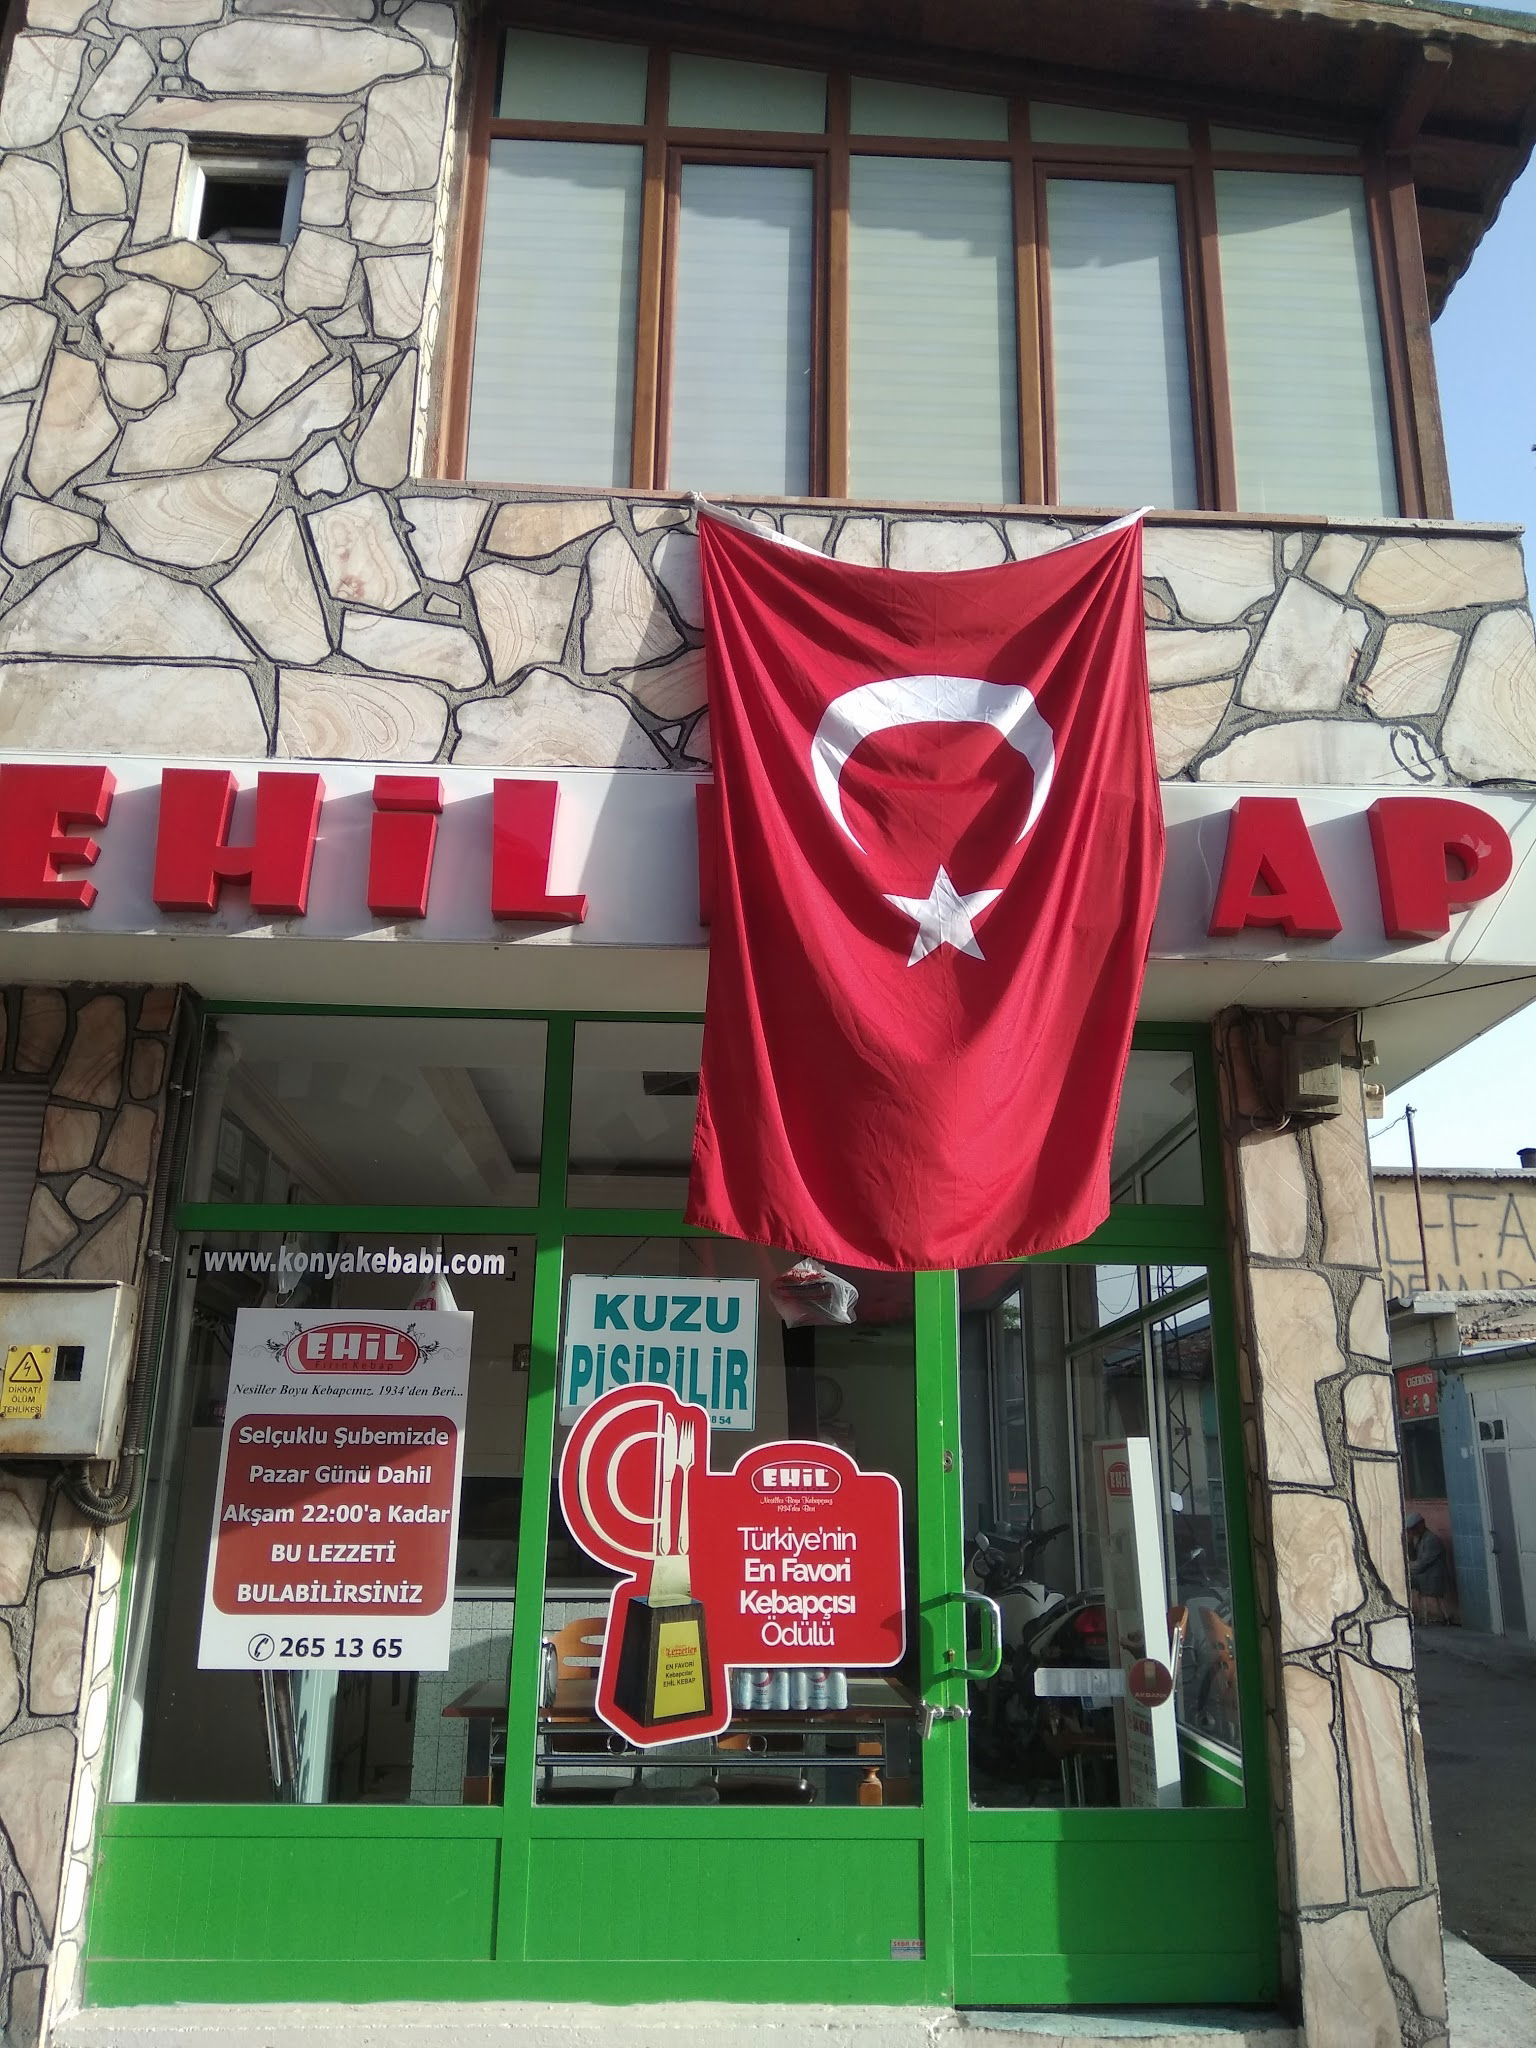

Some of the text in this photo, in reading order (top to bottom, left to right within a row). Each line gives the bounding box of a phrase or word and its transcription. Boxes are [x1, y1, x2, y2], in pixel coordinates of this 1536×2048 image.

[205, 1246, 505, 1279] www.konyakebabi.com
[593, 1293, 741, 1334] KUZU
[233, 1384, 277, 1396] Nesiller
[280, 1385, 308, 1398] Boyu
[432, 1385, 464, 1397] Beri...
[719, 1415, 732, 1425] 54
[238, 1426, 449, 1449] Selçuklu Şubemizde
[249, 1465, 432, 1485] Pazar Günü Dahil
[223, 1504, 451, 1527] Akşam 22:00'a Kadar
[271, 1540, 397, 1564] BU LEZZETİ
[737, 1526, 857, 1558] Türkiye'nin
[744, 1557, 851, 1582] En Favori
[237, 1580, 424, 1604] BULABİLİRSİNİZ
[740, 1589, 856, 1620] Kebapçısı
[761, 1615, 835, 1646] Ödülü
[279, 1637, 404, 1659] 265 13 65
[665, 1663, 674, 1671] EN
